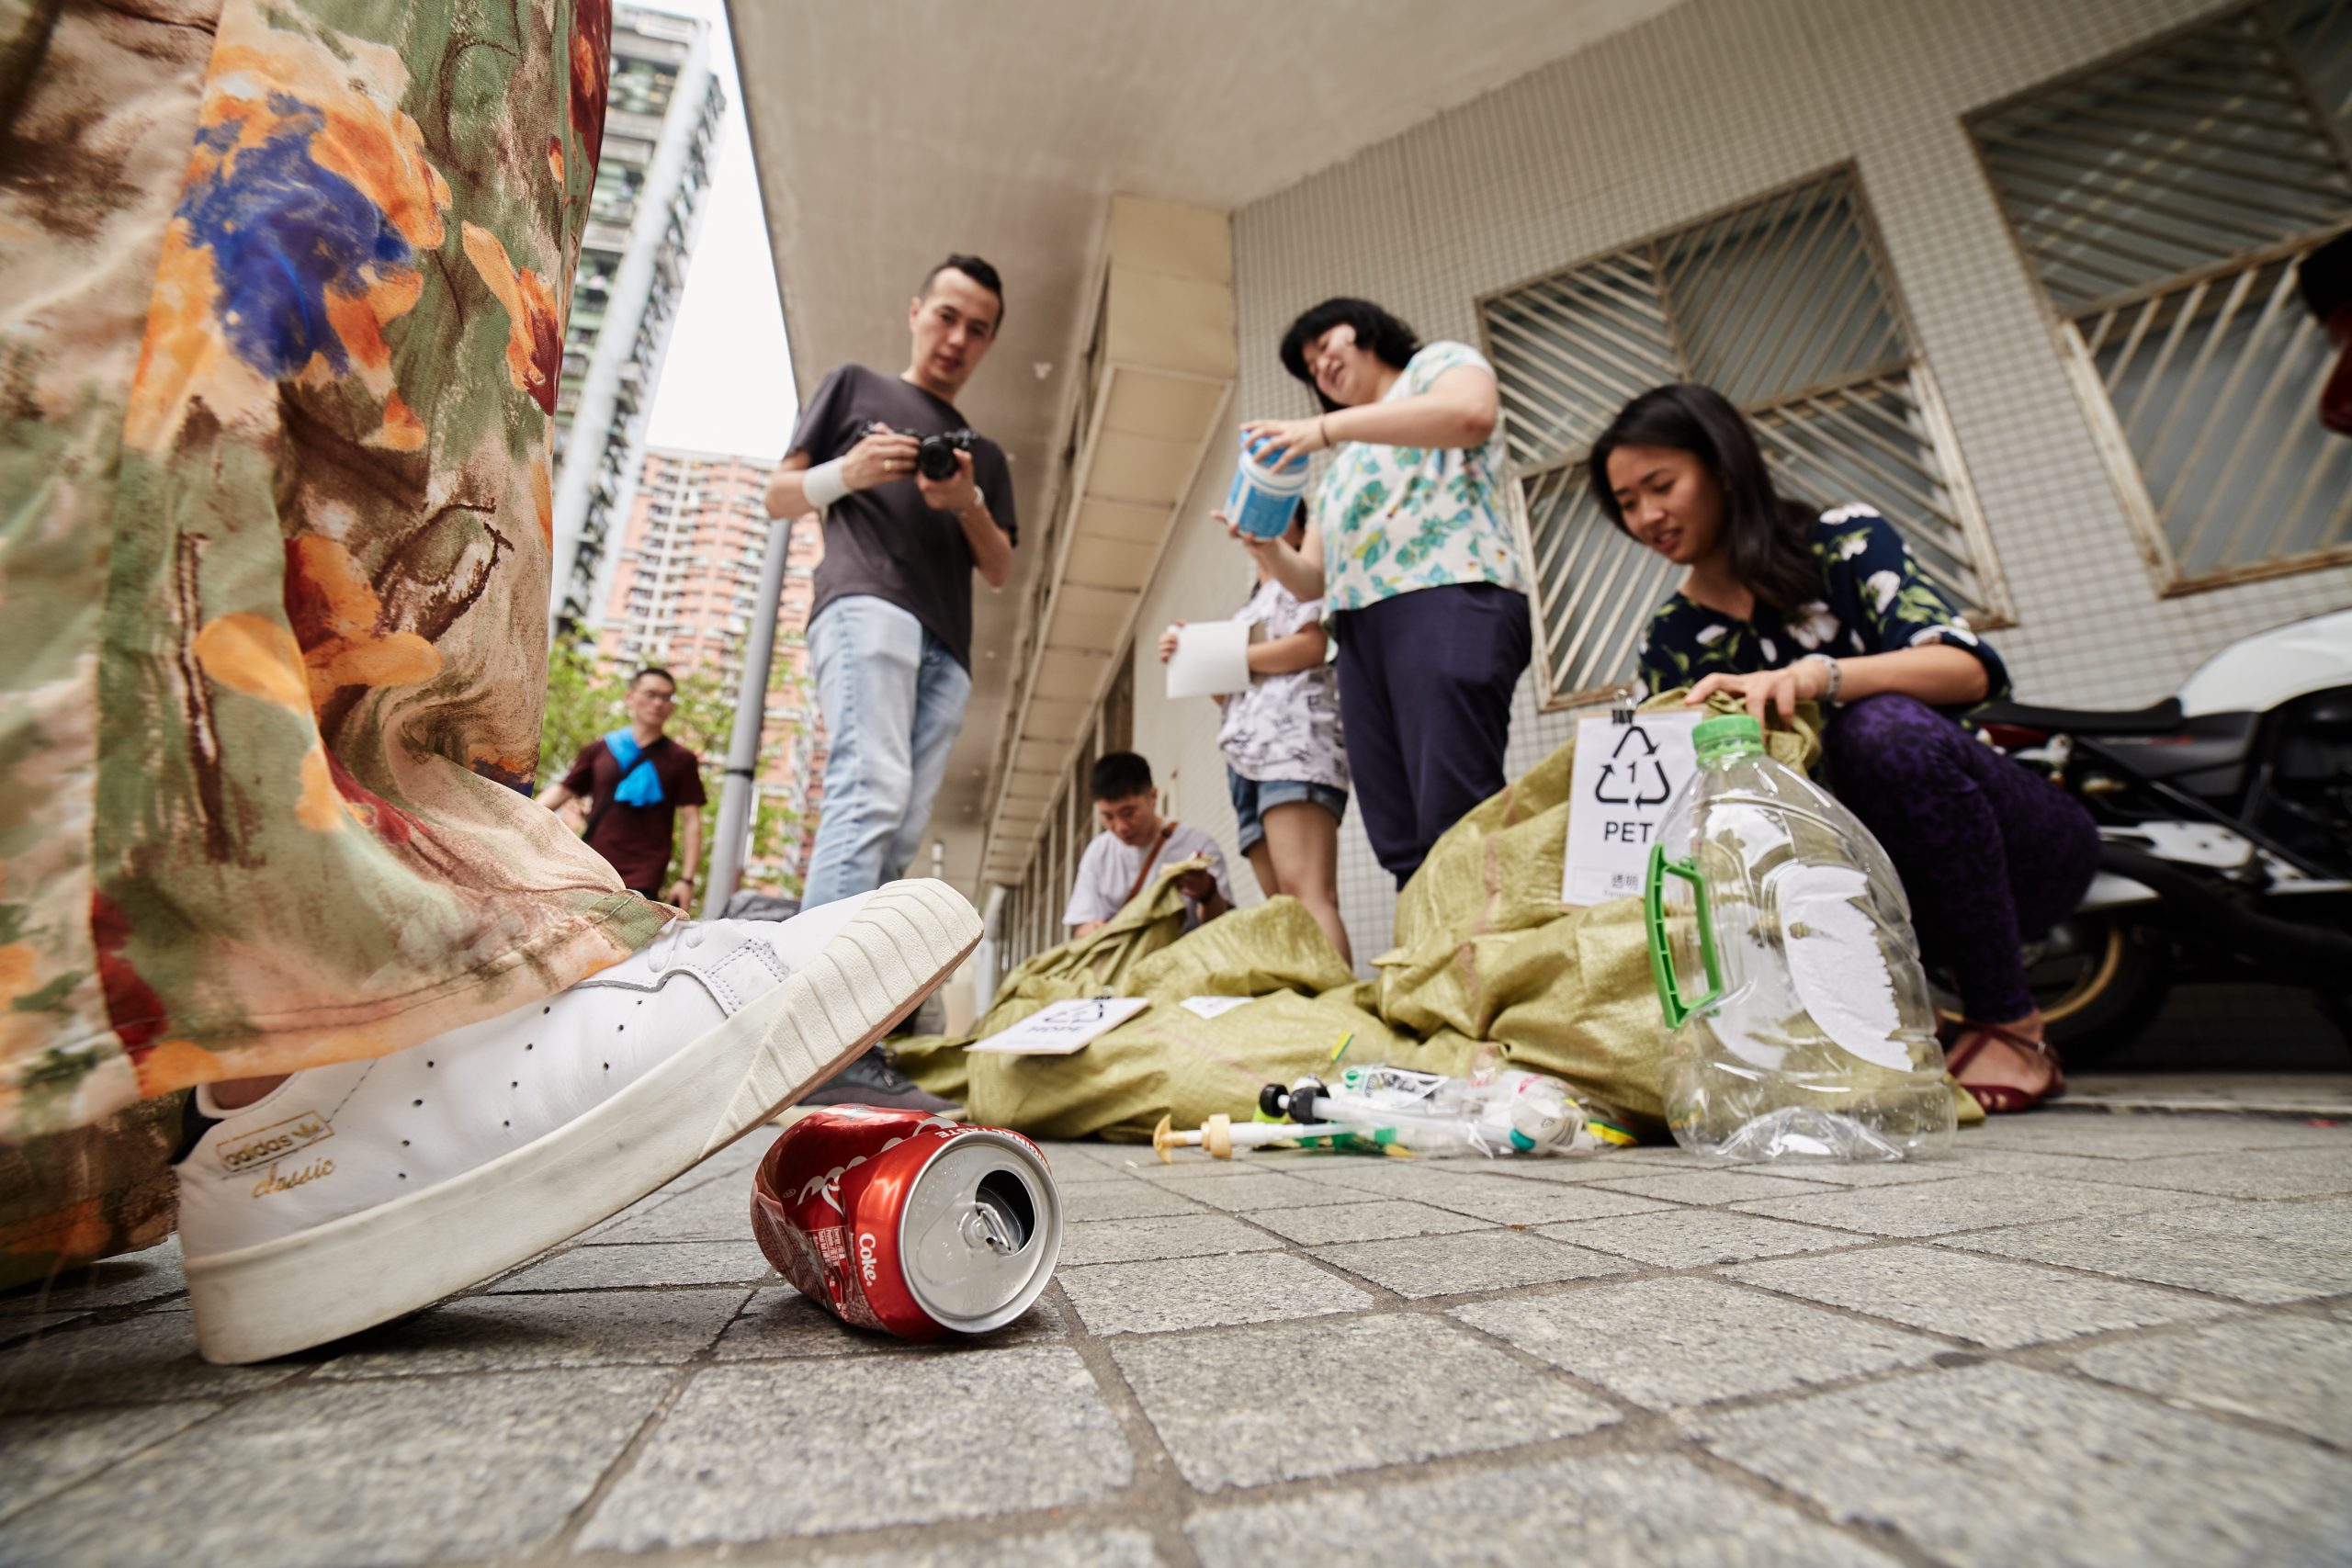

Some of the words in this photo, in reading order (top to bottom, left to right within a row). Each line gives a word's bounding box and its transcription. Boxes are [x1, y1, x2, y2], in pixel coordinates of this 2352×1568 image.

[1626, 761, 1637, 784] 1
[1603, 821, 1654, 842] PET
[224, 1134, 293, 1166] adidas
[252, 1157, 335, 1199] classic
